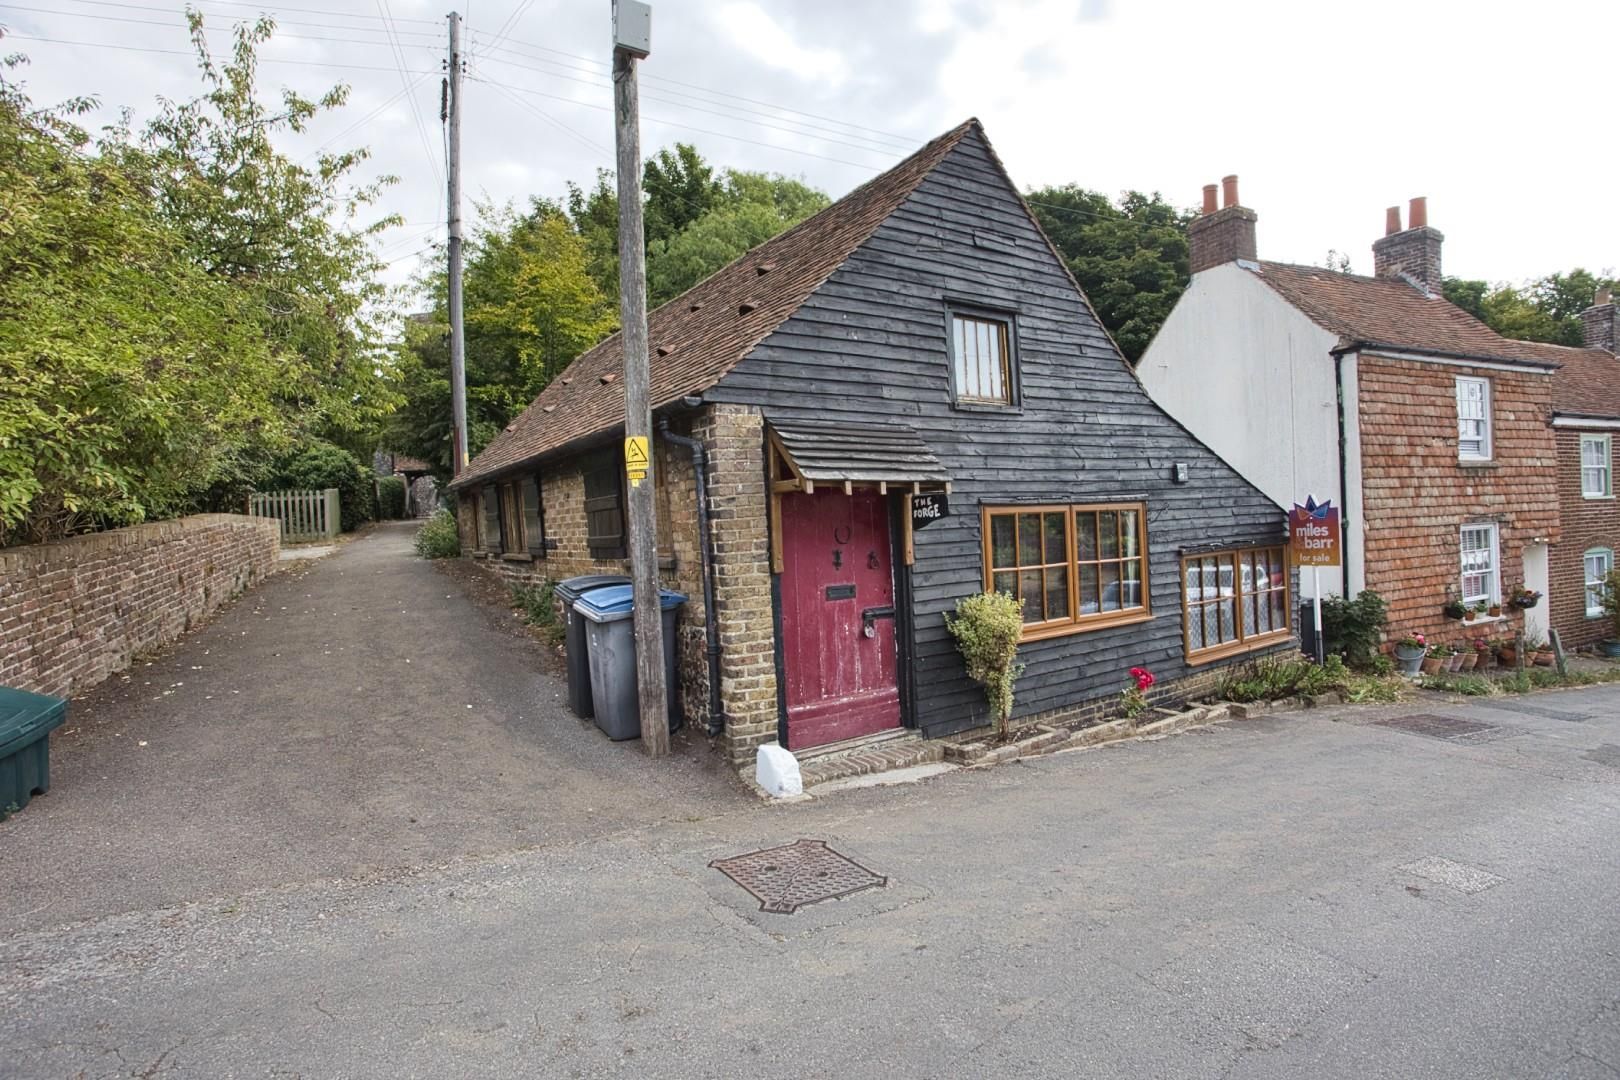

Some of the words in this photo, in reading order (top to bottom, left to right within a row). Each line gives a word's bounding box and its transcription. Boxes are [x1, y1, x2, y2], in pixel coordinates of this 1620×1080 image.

[914, 497, 932, 507] THE
[913, 503, 941, 518] FORGE
[1296, 522, 1329, 537] miles
[1304, 537, 1334, 549] barr
[1300, 553, 1311, 562] for
[1312, 553, 1330, 562] sale
